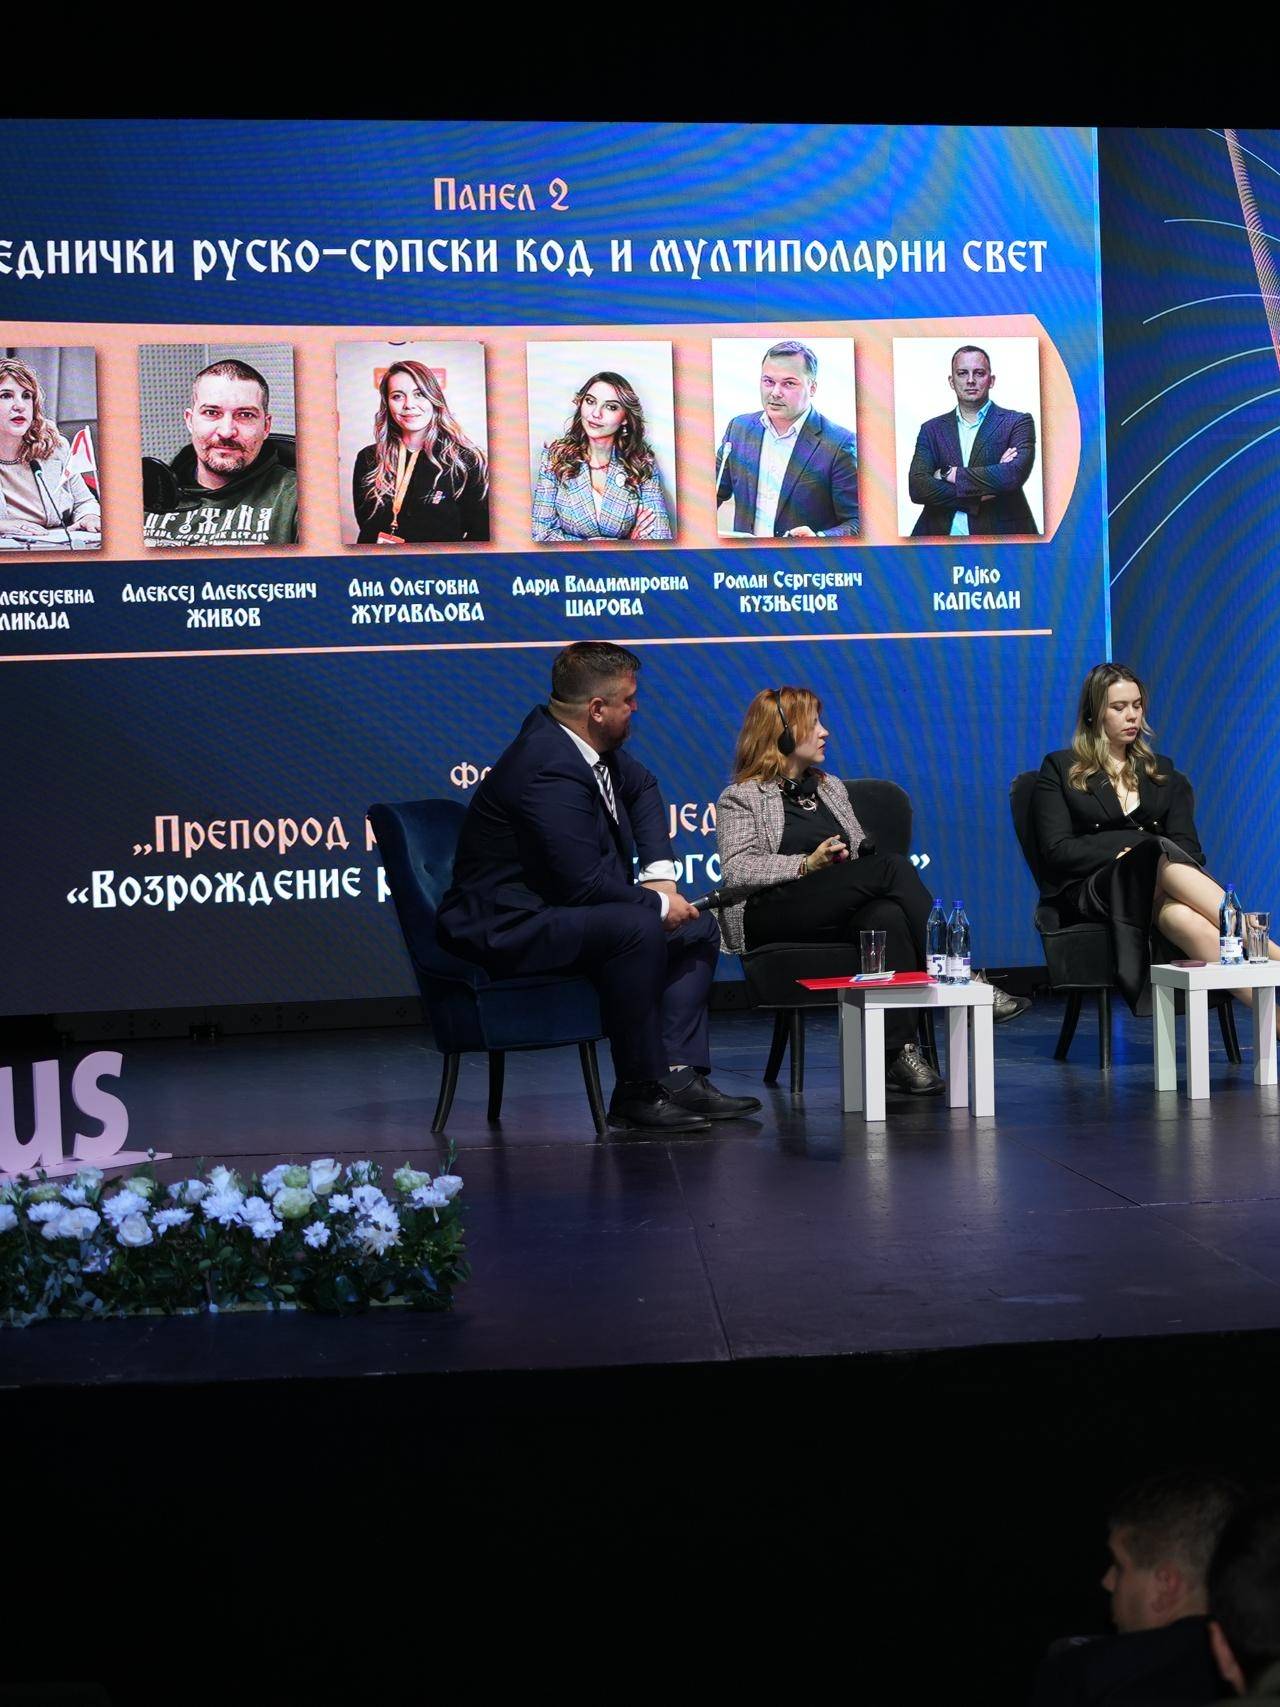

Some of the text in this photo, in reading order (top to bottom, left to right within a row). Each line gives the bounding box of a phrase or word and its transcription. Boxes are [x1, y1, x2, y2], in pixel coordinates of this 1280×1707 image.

[434, 177, 569, 211] Панел 2
[193, 238, 498, 280] руско-српски
[516, 238, 594, 277] код
[611, 239, 632, 272] и
[649, 238, 946, 280] мултиполарни
[962, 240, 1047, 273] свет
[512, 575, 689, 596] Дарја Владимировна
[713, 570, 863, 590] Роман Сергејевич
[953, 566, 1001, 586] Рајко
[121, 582, 317, 604] Алексеј Алексејевич
[348, 577, 479, 597] Ана Олеговна
[565, 598, 644, 617] ШАРОВА
[740, 593, 838, 613] КУЗЊЕЦОВ
[933, 590, 1020, 610] КАПЕЛАН
[186, 608, 261, 628] ЖИВОВ
[351, 602, 485, 624] ЖУРАВЉОВА
[133, 815, 349, 859] „Препород
[66, 867, 361, 911] «Возрождение
